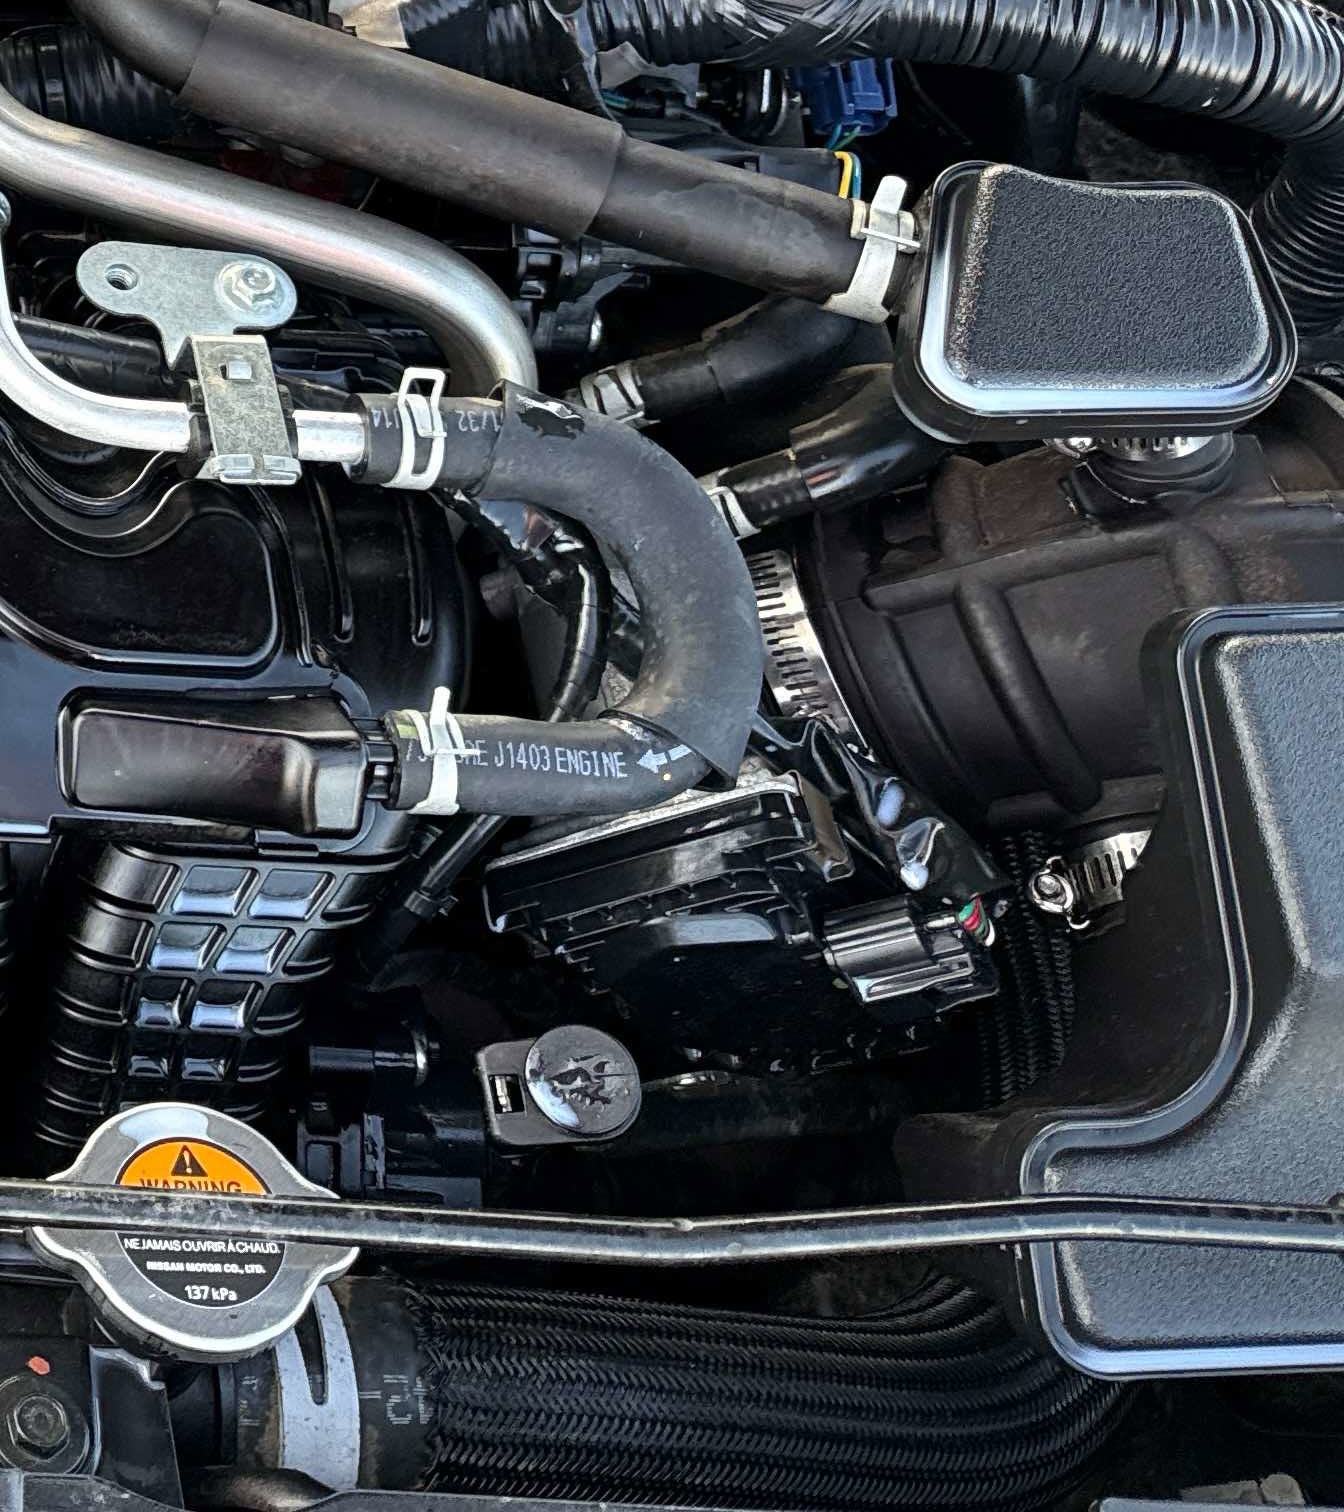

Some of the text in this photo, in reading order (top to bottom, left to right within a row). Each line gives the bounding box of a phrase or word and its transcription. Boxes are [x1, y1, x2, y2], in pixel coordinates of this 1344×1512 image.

[494, 742, 551, 771] J1403
[555, 750, 628, 778] ENGINE
[124, 1238, 139, 1250] NE
[140, 1239, 181, 1252] JAMAIS
[182, 1240, 226, 1252] OUVRIR
[236, 1241, 281, 1254] CHAUD.
[146, 1261, 184, 1272] NISSAN
[186, 1262, 222, 1273] MOTOR
[184, 1284, 238, 1301] 137 kPa
